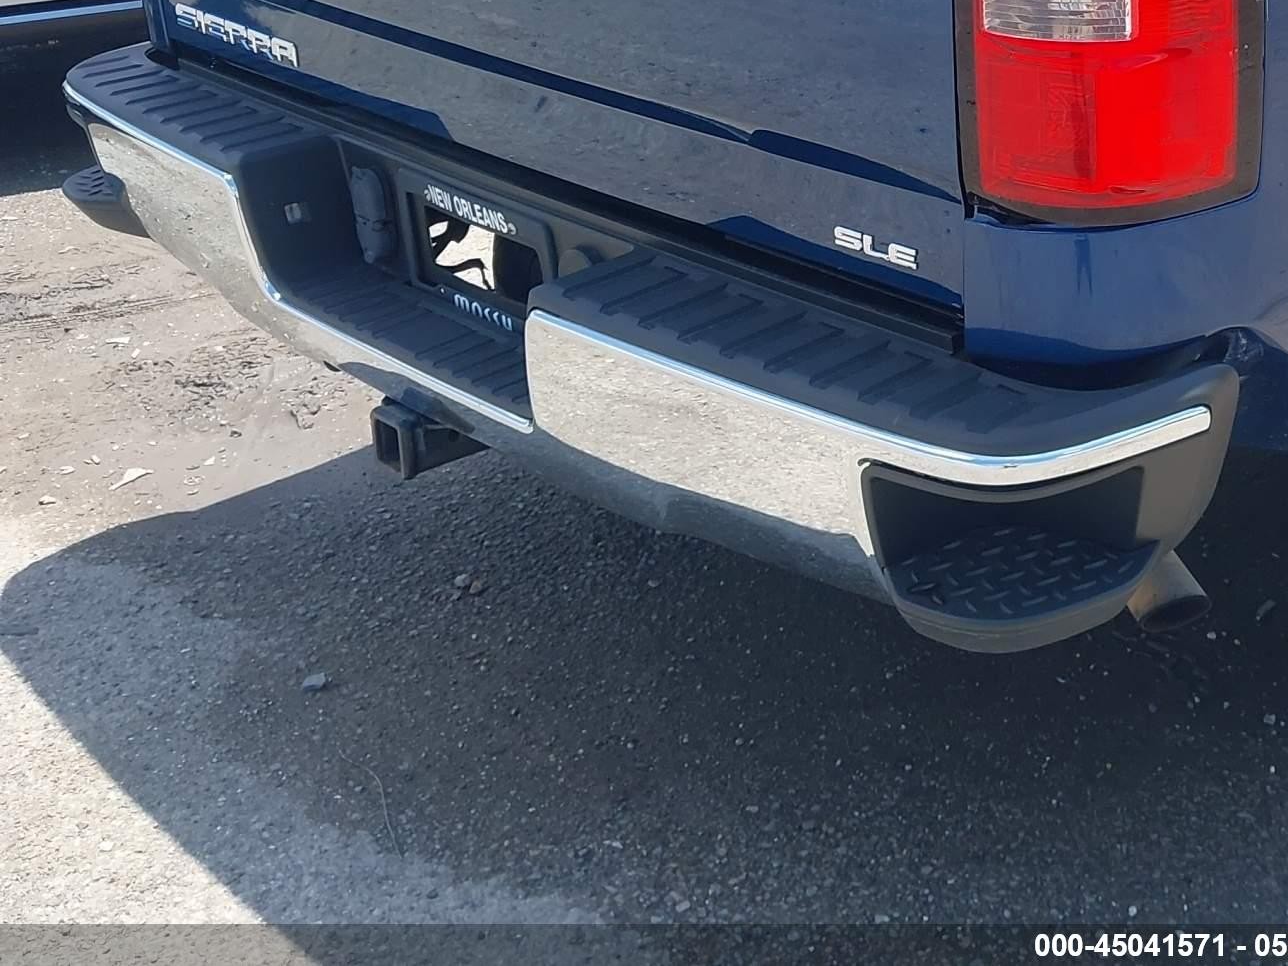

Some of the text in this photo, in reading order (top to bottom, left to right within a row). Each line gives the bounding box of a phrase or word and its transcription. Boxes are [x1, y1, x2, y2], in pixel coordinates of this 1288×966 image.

[175, 2, 299, 68] SIERRA
[427, 184, 509, 234] NEW ORLEANS
[833, 225, 918, 270] SLE
